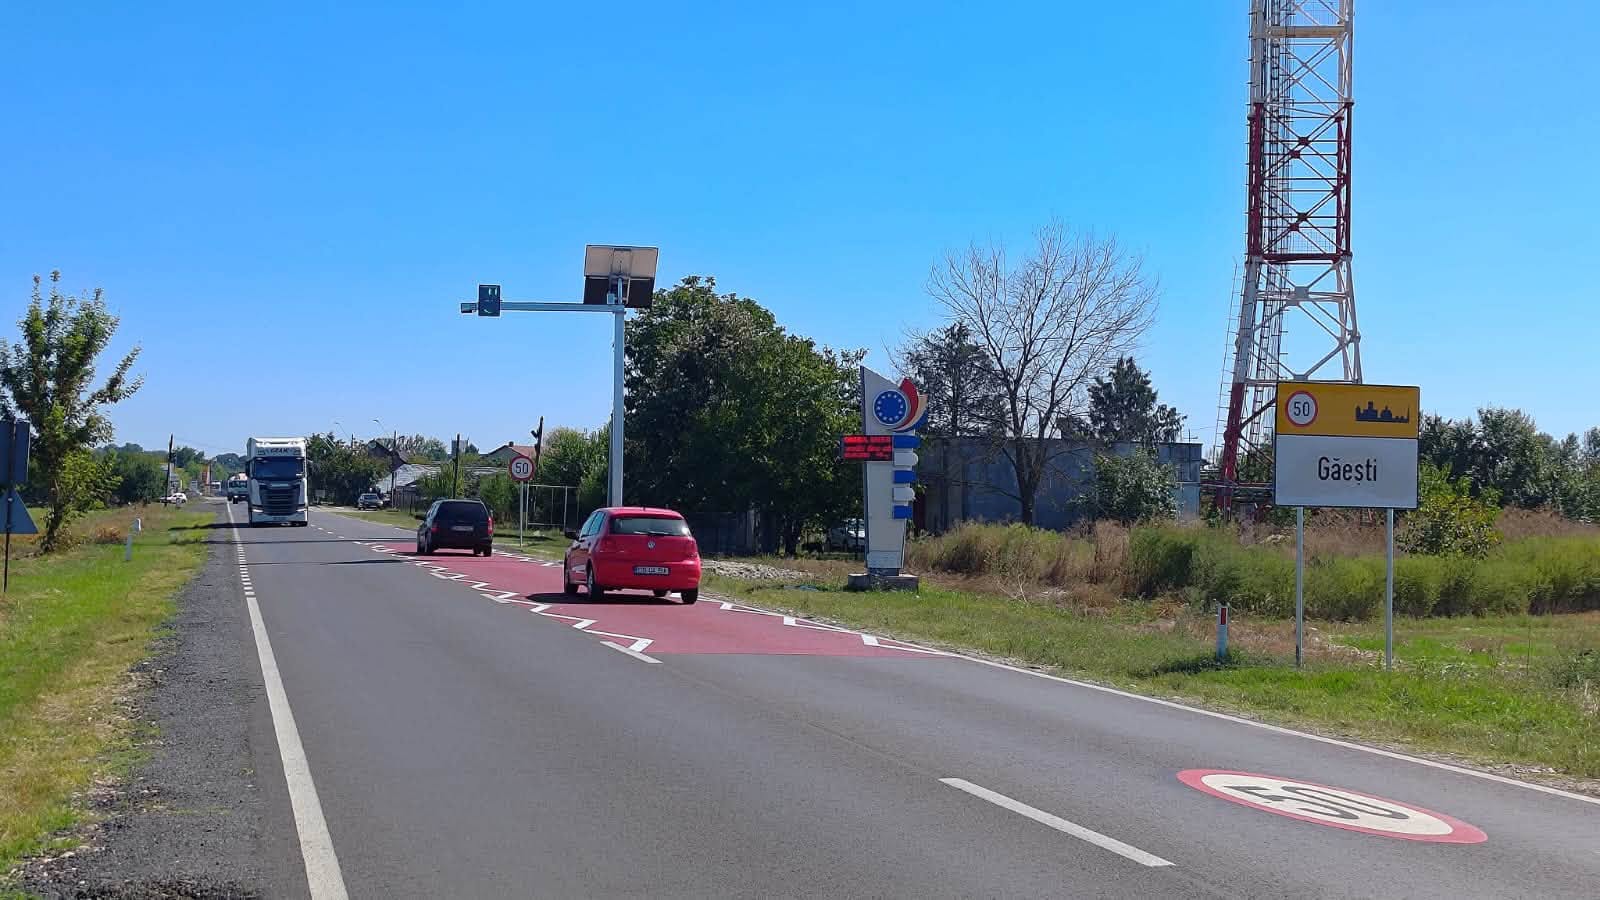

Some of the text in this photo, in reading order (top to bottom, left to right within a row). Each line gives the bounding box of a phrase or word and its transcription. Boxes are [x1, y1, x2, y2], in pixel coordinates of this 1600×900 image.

[1294, 401, 1310, 417] 50
[515, 462, 529, 474] 50
[1318, 456, 1377, 485] Găești
[1224, 785, 1410, 821] 50
